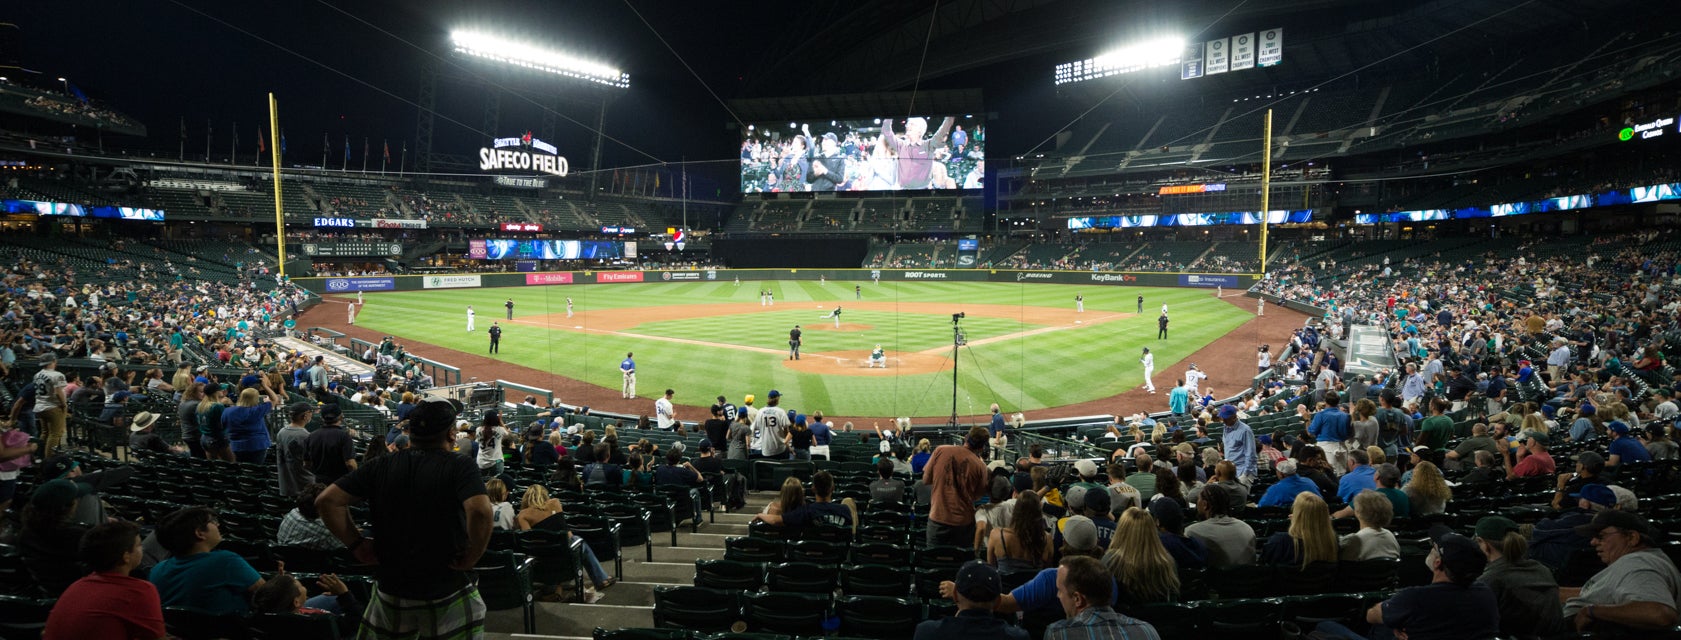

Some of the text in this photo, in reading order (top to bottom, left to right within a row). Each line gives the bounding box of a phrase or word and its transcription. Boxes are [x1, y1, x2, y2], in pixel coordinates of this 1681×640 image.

[479, 147, 569, 178] SAFECO FIELD
[376, 219, 401, 229] Coors
[1091, 273, 1123, 282] KeyBank
[764, 416, 777, 428] 13
